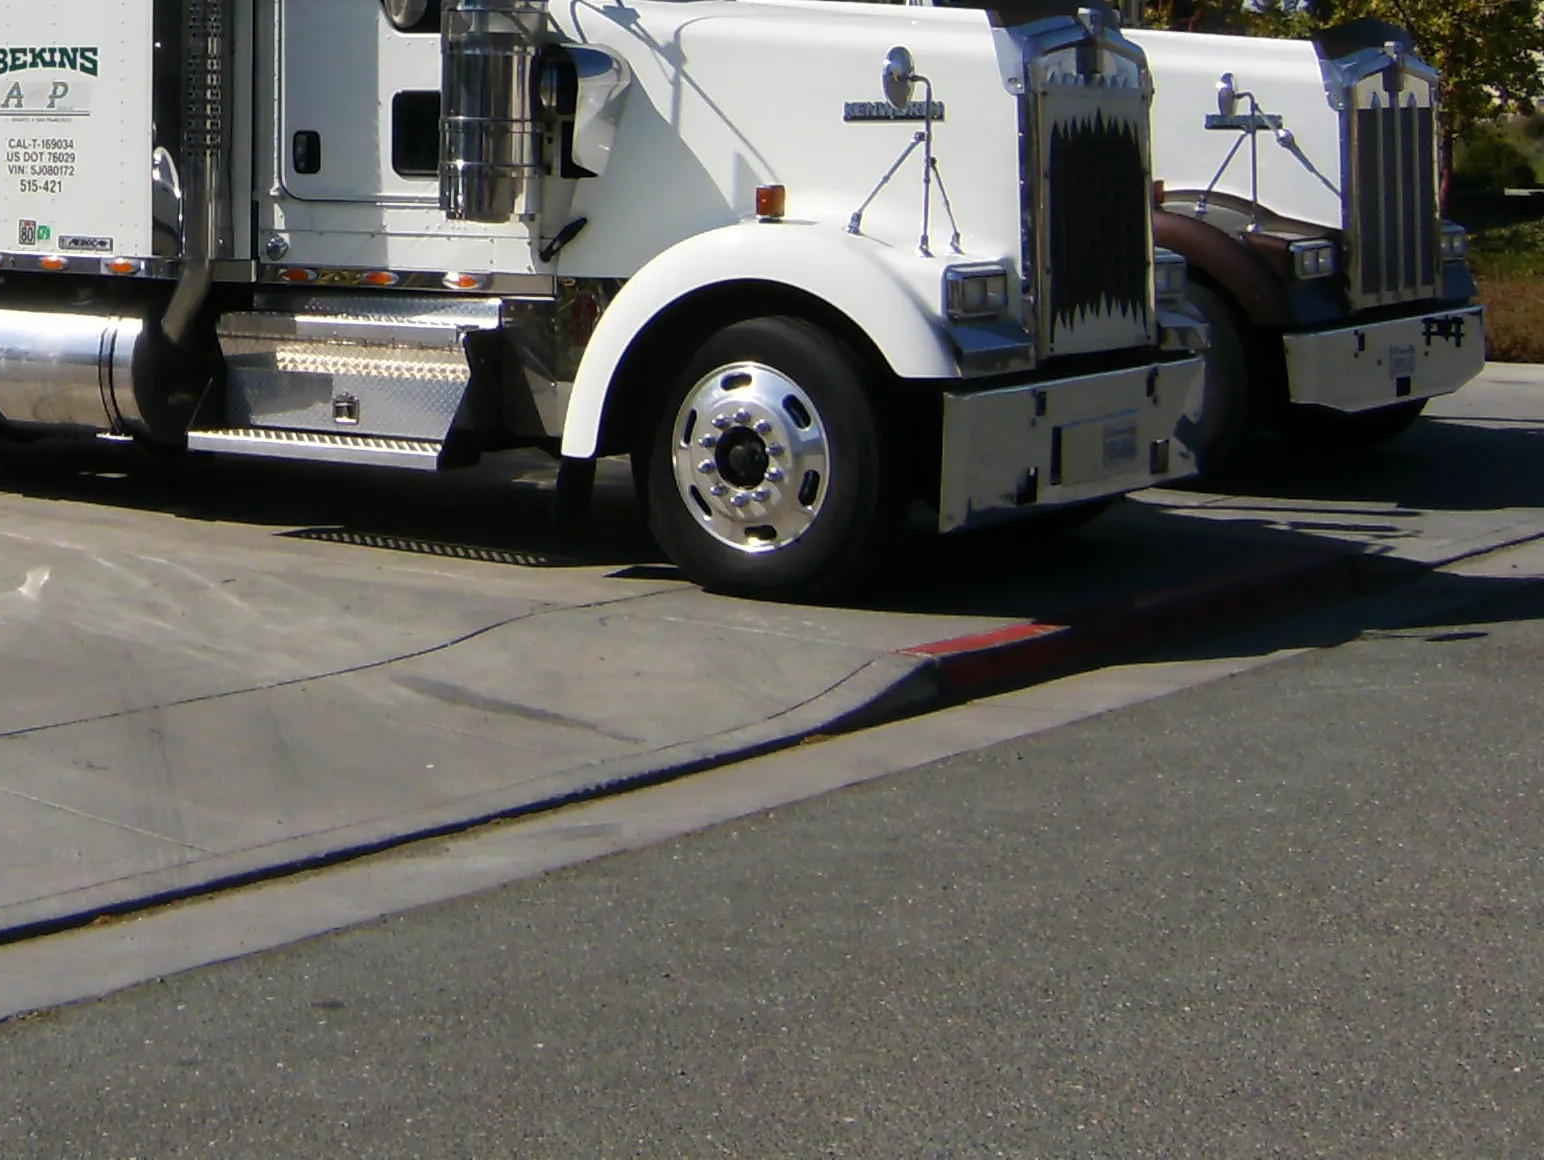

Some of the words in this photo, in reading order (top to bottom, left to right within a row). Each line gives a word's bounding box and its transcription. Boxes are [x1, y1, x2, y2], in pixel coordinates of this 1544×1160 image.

[0, 80, 24, 109] A
[46, 80, 69, 109] P
[8, 138, 74, 150] CAL-T-169034
[6, 151, 21, 162] US
[23, 151, 44, 162] DOT
[47, 151, 76, 164] 76029
[8, 164, 28, 175] VIN:
[19, 179, 62, 193] 515-421
[20, 226, 34, 242] 80
